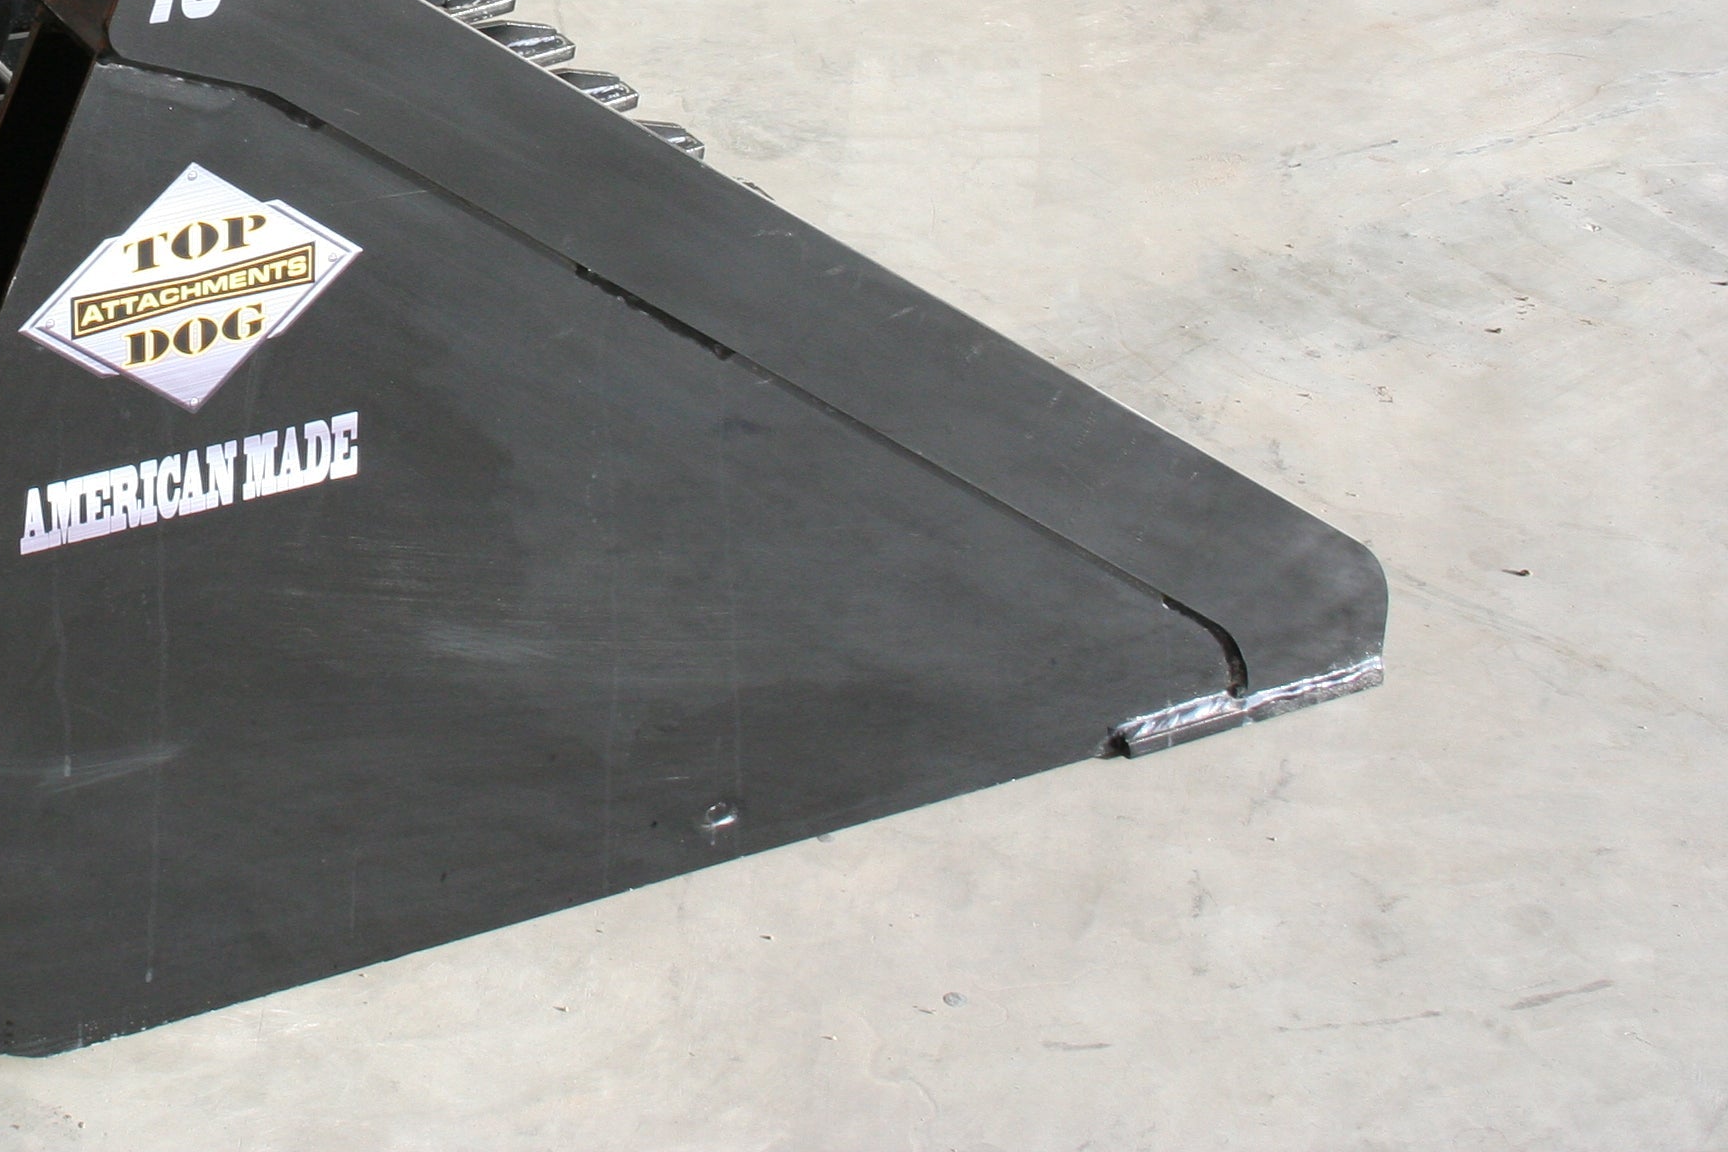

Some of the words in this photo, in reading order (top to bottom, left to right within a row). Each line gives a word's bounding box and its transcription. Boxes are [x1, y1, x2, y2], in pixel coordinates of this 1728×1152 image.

[122, 214, 267, 274] TOP
[80, 254, 308, 327] ATTACHMENTS
[122, 302, 266, 367] DOG
[19, 439, 239, 556] AMERICAN
[241, 410, 359, 502] MADE
